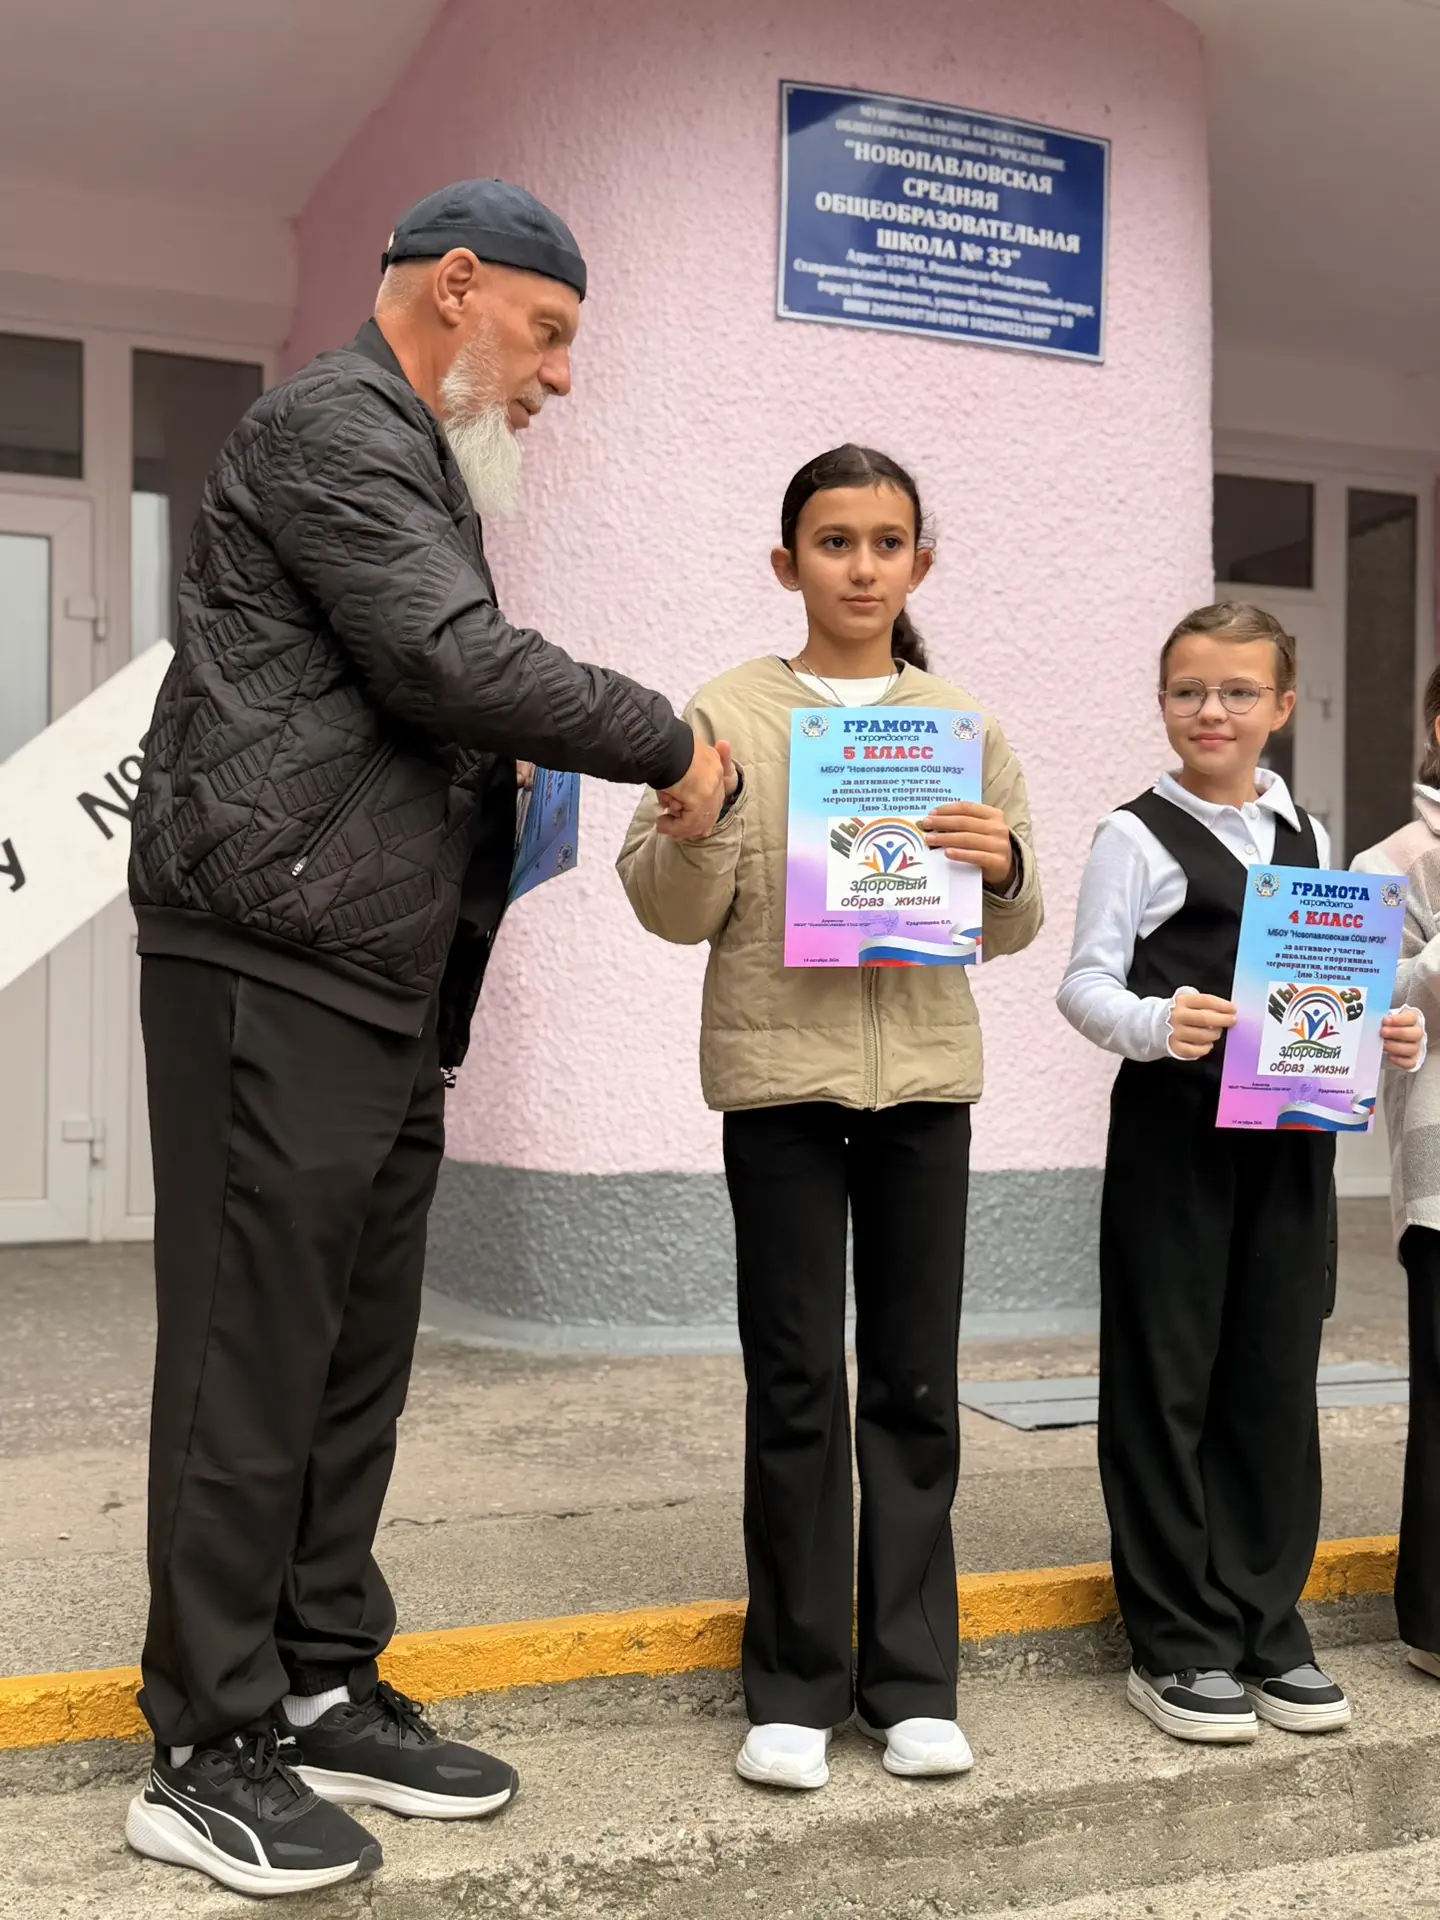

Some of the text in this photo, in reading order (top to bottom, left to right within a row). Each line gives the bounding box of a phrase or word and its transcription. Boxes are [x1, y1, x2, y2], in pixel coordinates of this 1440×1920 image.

[844, 138, 1053, 195] "НОВОПАВЛОВСКАЯ
[902, 176, 999, 212] СРЕДНЯЯ
[815, 191, 1081, 254] ОБЩЕОБРАЗОВАТЕЛЬНАЯ
[876, 228, 1021, 269] ШКОЛА № 33"
[843, 719, 939, 734] ГРАМОТА
[854, 733, 920, 743] награждается
[843, 746, 934, 760] 5 КЛАСС
[820, 765, 845, 774] МБОУ
[847, 765, 919, 774] "Новопавловская
[920, 765, 941, 773] СОШ
[901, 778, 941, 786] участие
[892, 787, 952, 795] спортивном
[858, 803, 927, 812] Дню Здоровья
[849, 876, 927, 894] здоровый
[1291, 881, 1370, 901] ГРАМОТА
[840, 895, 941, 909] образ жизни
[1288, 910, 1364, 929] 4 КЛАСС
[1267, 928, 1288, 937] МБОУ
[1350, 935, 1367, 943] СОШ
[1294, 945, 1332, 953] активное
[1333, 947, 1366, 955] участие
[1281, 953, 1323, 962] школьном
[1324, 956, 1373, 965] спортивном
[1294, 970, 1351, 981] Дню Здоровья
[1278, 1046, 1342, 1060] здоровый
[1269, 1060, 1350, 1075] образ жизни
